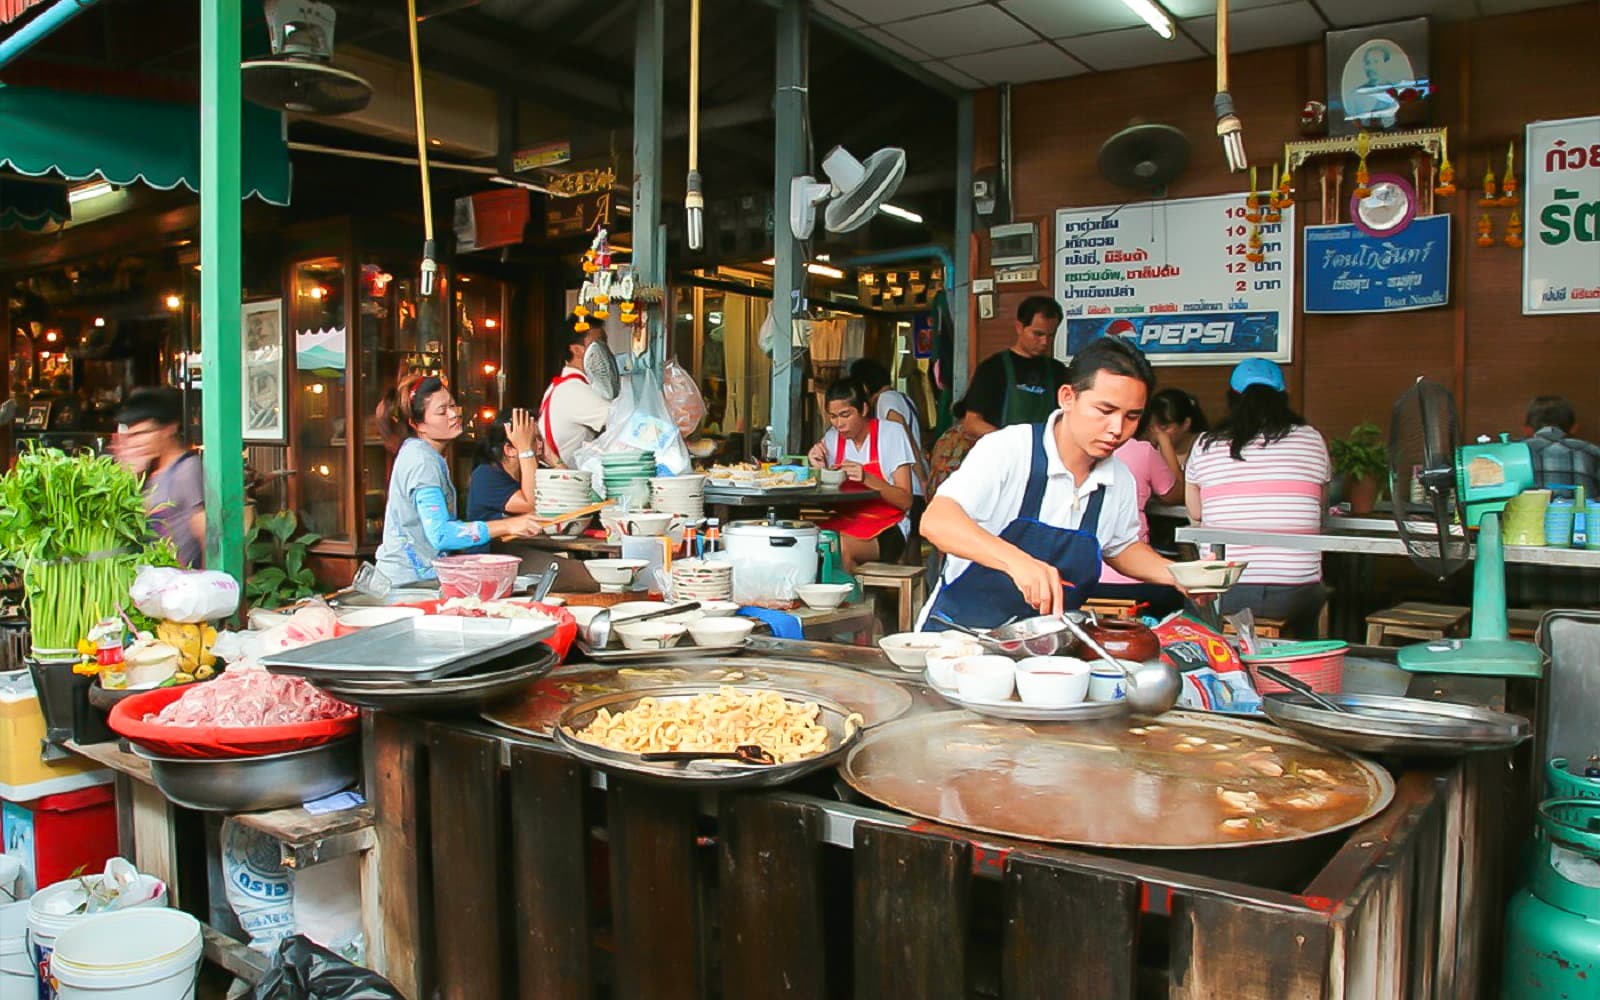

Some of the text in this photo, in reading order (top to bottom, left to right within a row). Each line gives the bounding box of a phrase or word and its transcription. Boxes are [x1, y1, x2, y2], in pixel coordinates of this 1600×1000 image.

[1065, 217, 1119, 233] ชาดำเย็น
[1225, 207, 1246, 219] 10
[1226, 225, 1246, 237] 10
[1225, 243, 1247, 256] 12
[1225, 262, 1247, 274] 12
[1254, 260, 1282, 272] บาท
[1236, 280, 1247, 292] 2
[1254, 279, 1281, 291] บาท
[1140, 321, 1235, 345] PEPSI
